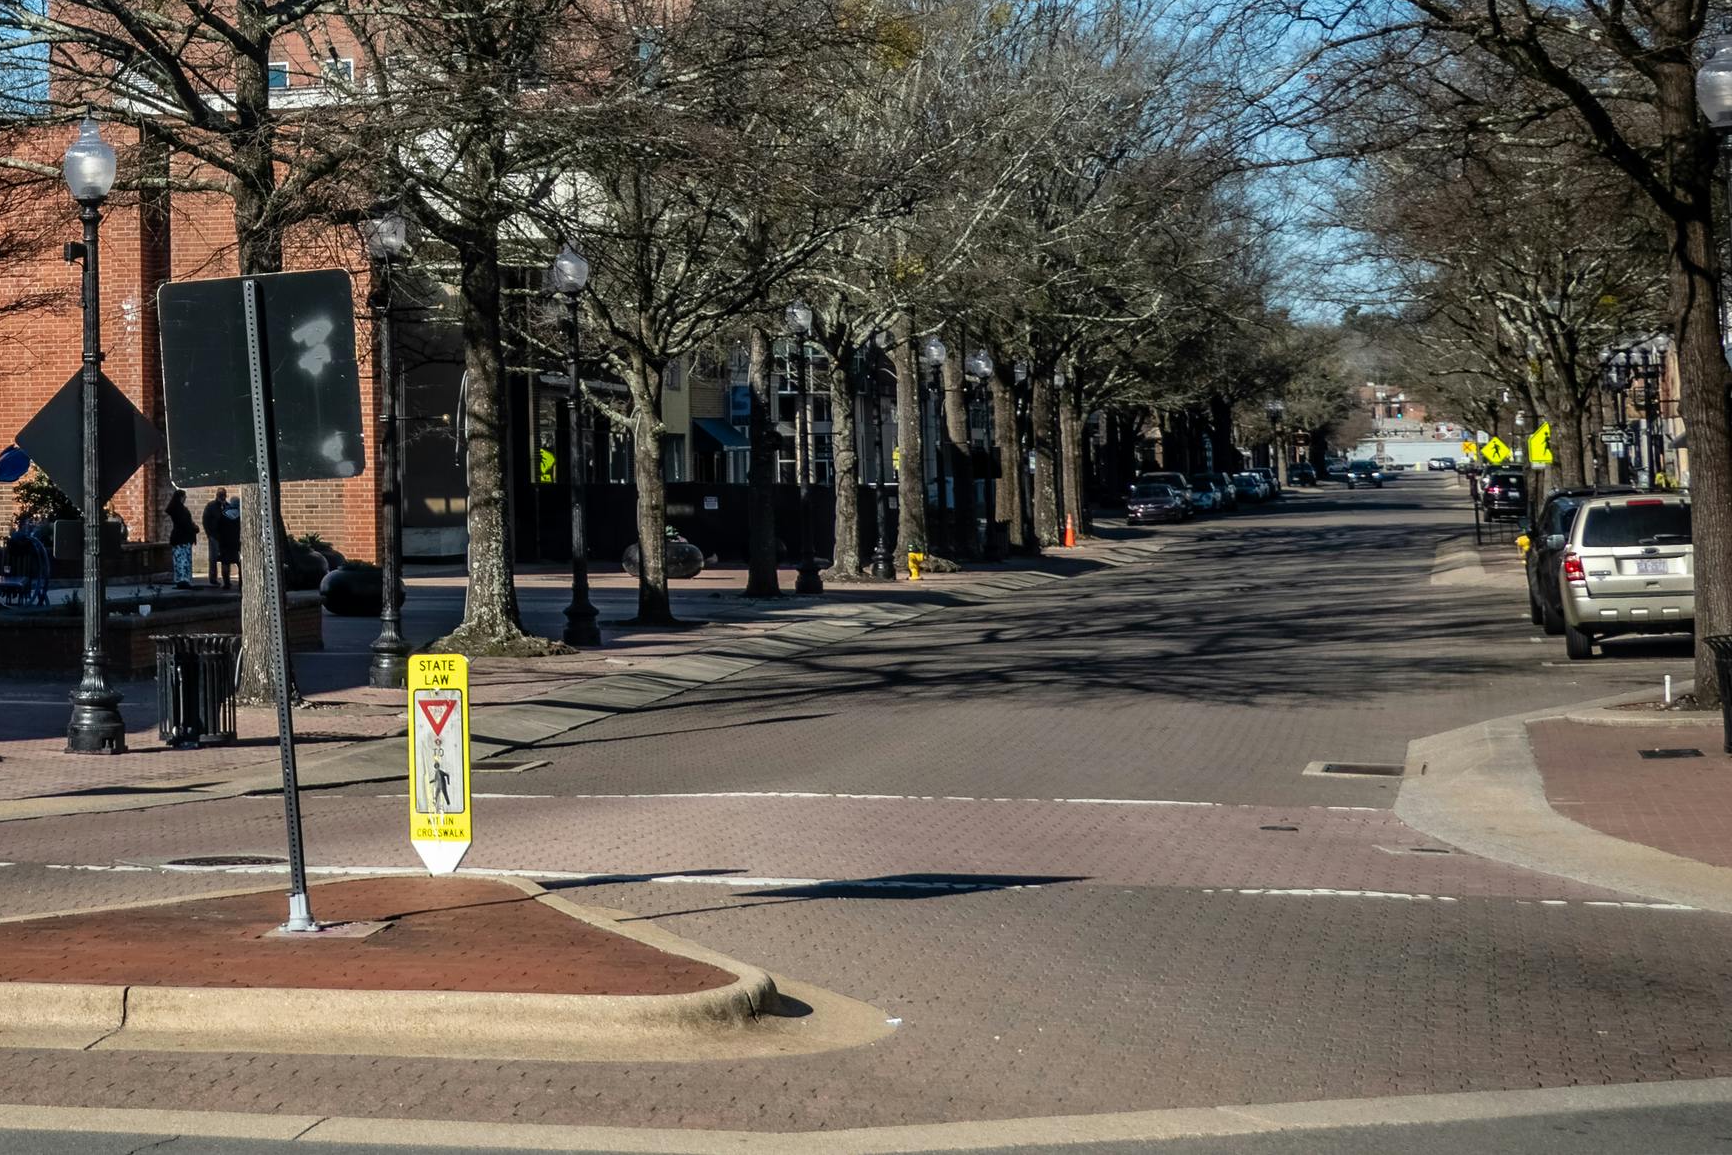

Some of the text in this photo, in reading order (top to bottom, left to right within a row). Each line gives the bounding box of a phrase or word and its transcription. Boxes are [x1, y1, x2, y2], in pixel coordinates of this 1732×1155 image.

[419, 660, 456, 672] STATE
[424, 674, 450, 686] LAW
[432, 747, 445, 757] TO
[416, 828, 465, 838] CROSWALK
